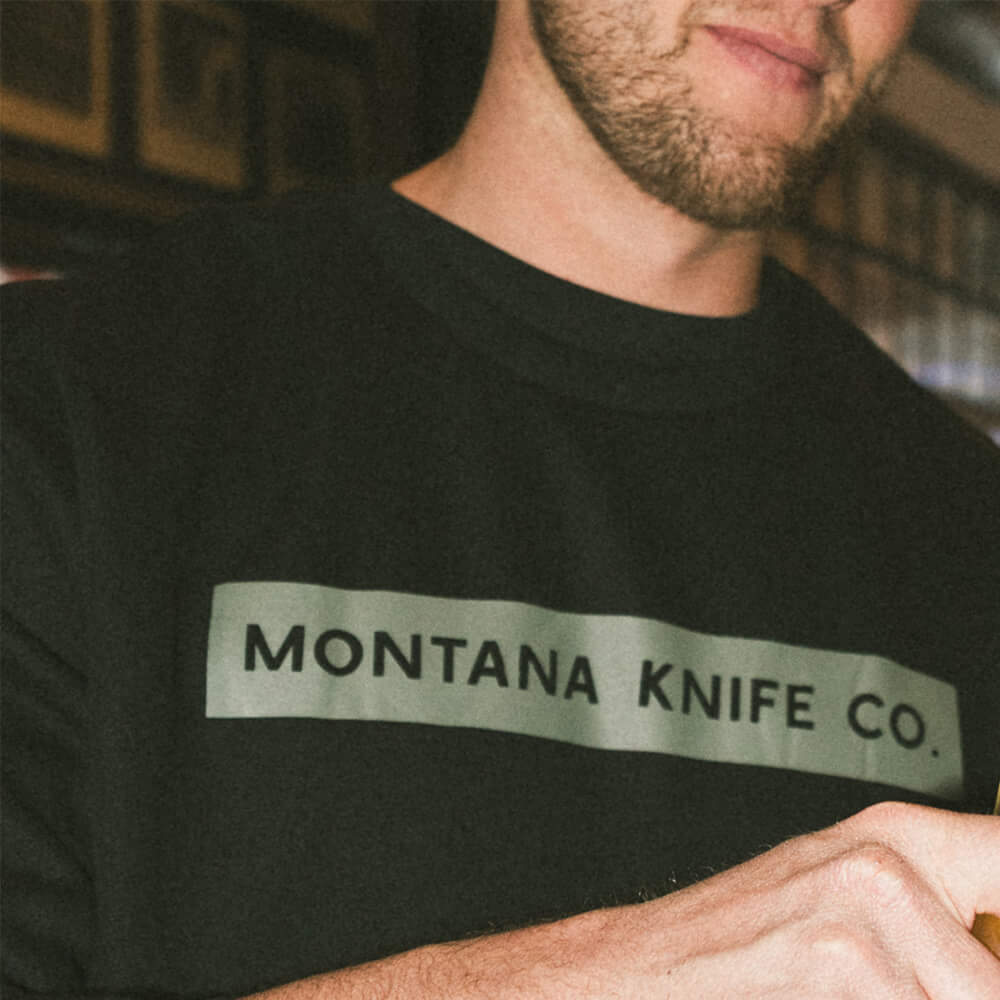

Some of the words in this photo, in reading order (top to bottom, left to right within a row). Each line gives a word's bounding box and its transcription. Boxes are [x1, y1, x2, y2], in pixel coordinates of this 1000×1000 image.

[244, 623, 599, 704] MONTANA
[638, 659, 815, 730] KNIFE
[847, 693, 939, 758] CO.
